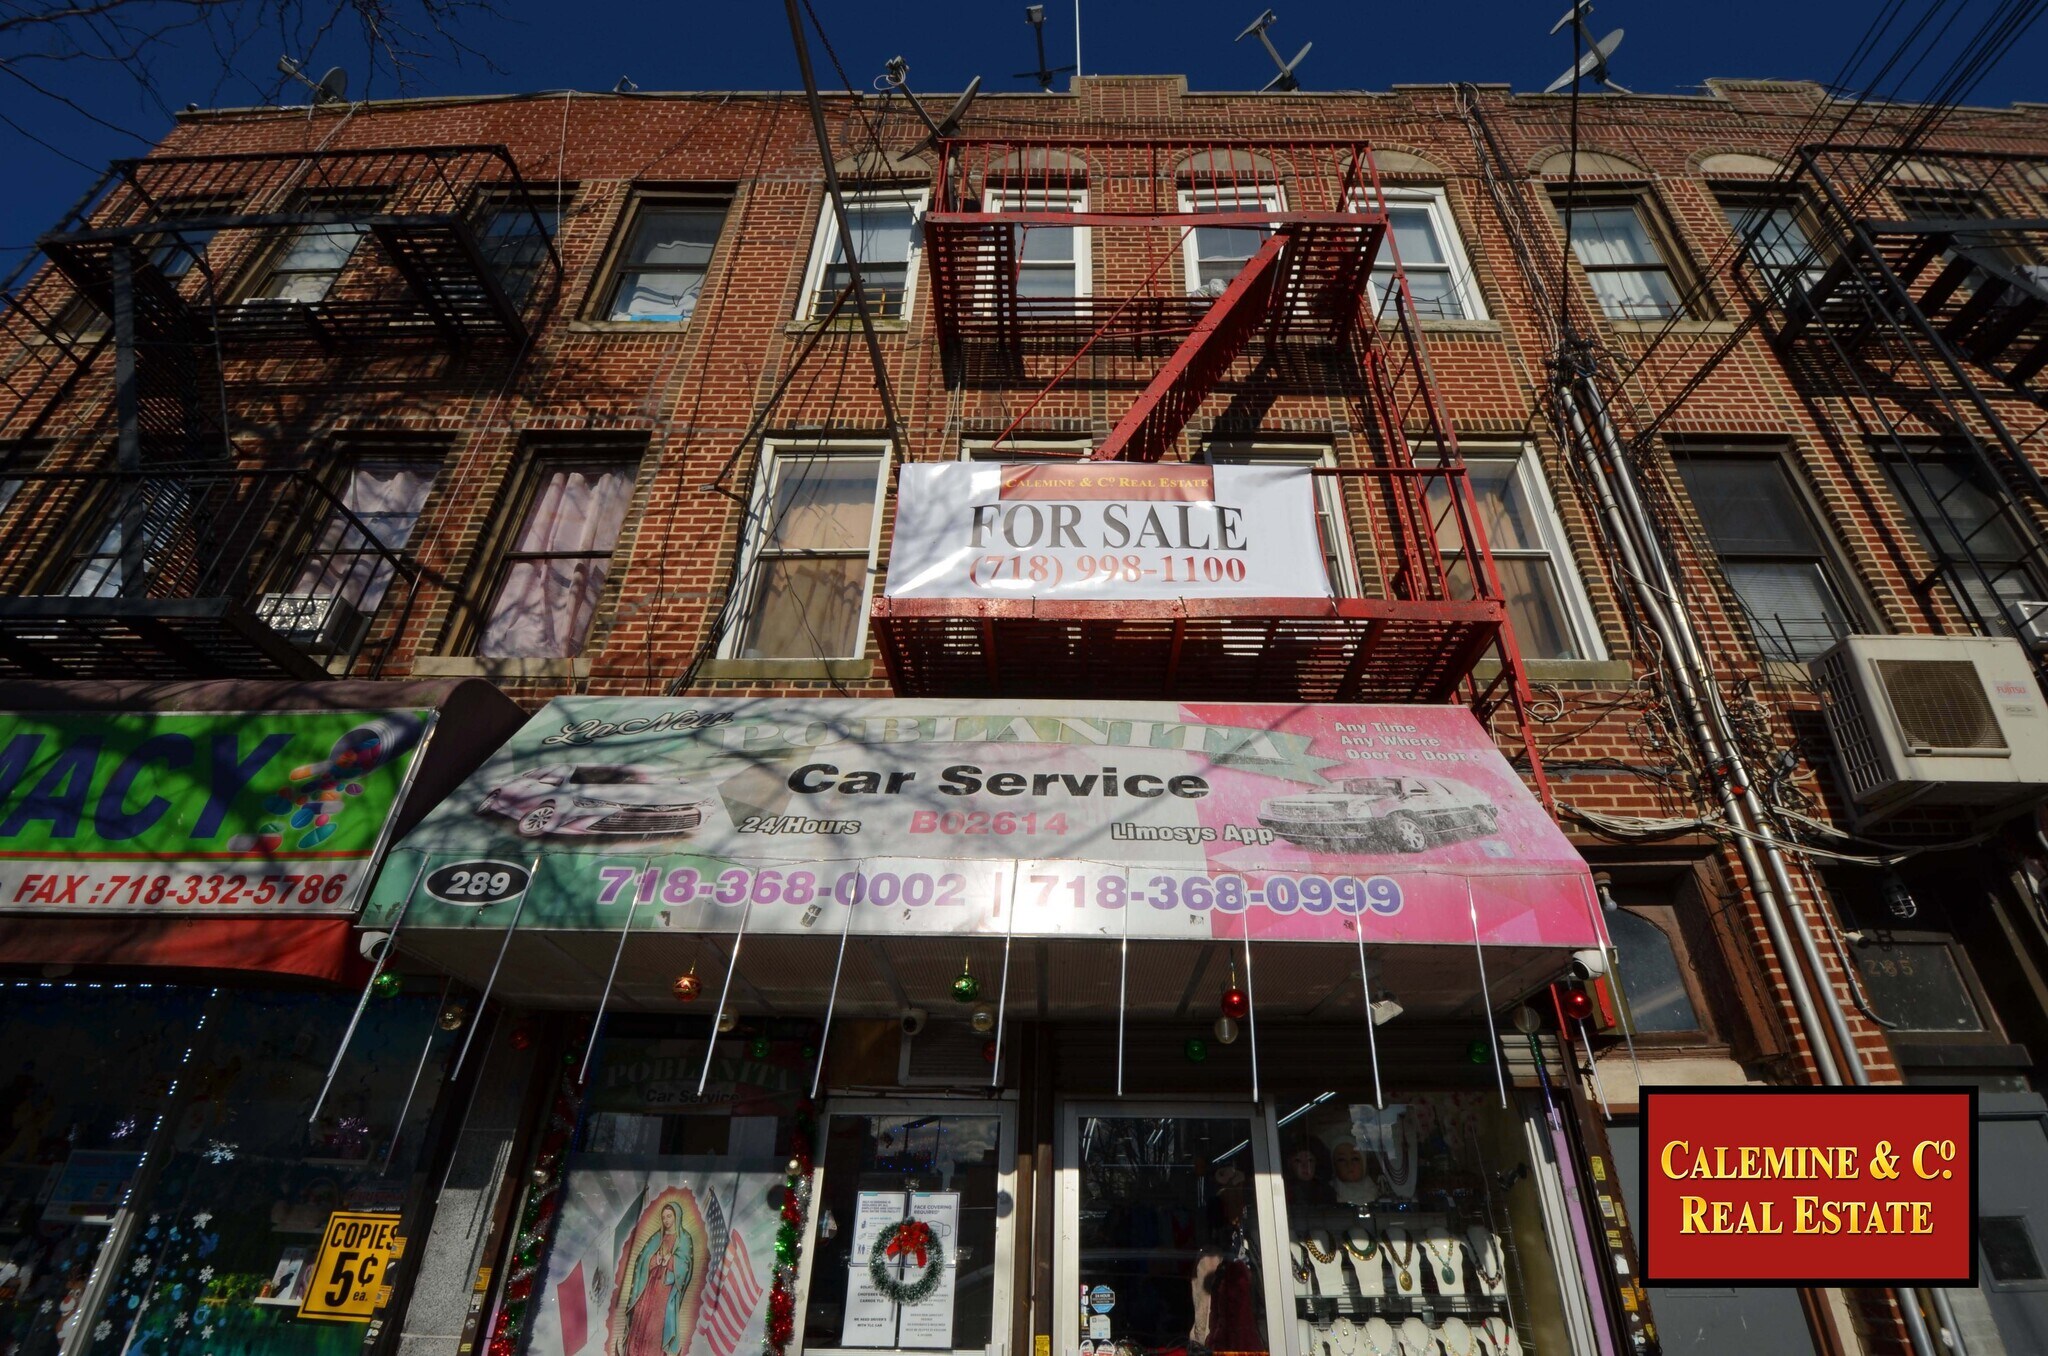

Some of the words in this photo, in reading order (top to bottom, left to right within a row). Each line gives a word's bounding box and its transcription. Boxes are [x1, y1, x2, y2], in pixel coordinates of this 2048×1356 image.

[1005, 477, 1075, 489] CALEMINE
[1079, 477, 1093, 489] &
[1119, 477, 1155, 489] REAL
[1159, 477, 1209, 489] ESTATE
[966, 503, 1087, 549] FOR
[1102, 503, 1247, 551] SALE
[968, 555, 1063, 588] (718)
[1075, 555, 1247, 583] 998-1100
[1997, 686, 2026, 694] FUJITSU
[717, 715, 1292, 760] POBLANITA
[1334, 721, 1367, 734] Any
[1370, 721, 1417, 734] Time
[1340, 734, 1374, 748] Any
[1378, 735, 1441, 747] Where
[1345, 748, 1391, 761] Door
[1396, 749, 1418, 761] to
[1420, 750, 1468, 762] Door
[787, 763, 915, 796] Car
[938, 765, 1211, 799] Service
[738, 813, 862, 836] 24/Hours
[909, 810, 1071, 837] B02614
[1111, 821, 1217, 845] Limosys
[1222, 823, 1276, 846] App
[13, 874, 90, 904] FAX
[445, 870, 512, 897] 289
[596, 865, 968, 909] 718-368-0002
[1028, 872, 1404, 917] 718-368-0999
[1864, 958, 1915, 978] 285
[645, 1088, 674, 1104] Car
[330, 1221, 399, 1251] COPIES
[353, 1291, 369, 1302] ea.
